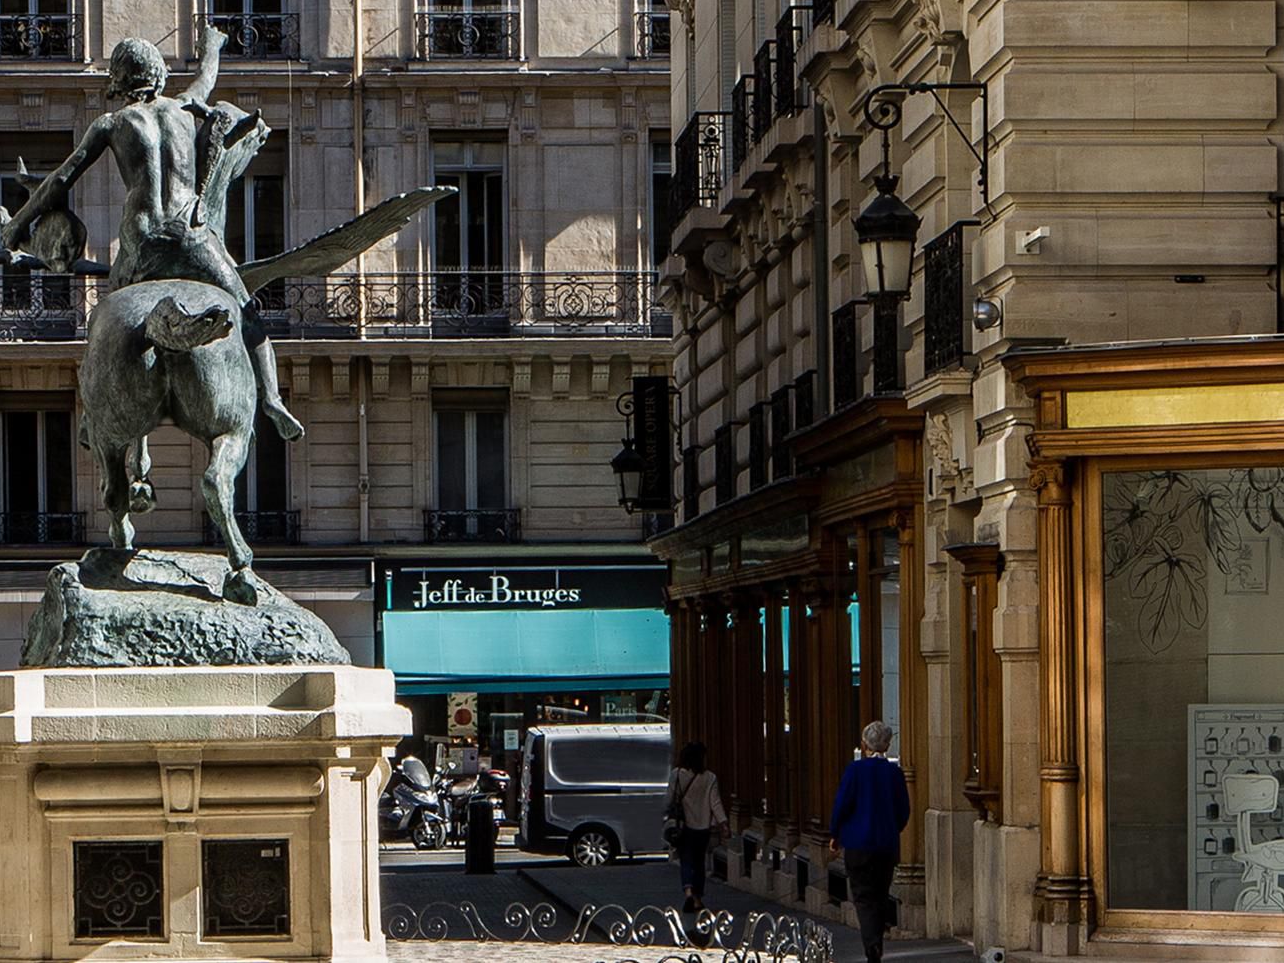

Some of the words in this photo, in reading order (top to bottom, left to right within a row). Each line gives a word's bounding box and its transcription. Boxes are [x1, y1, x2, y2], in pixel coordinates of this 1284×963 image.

[413, 579, 462, 608] Jeff
[464, 587, 486, 603] de
[489, 575, 581, 607] Bruges
[605, 702, 638, 717] Paris
